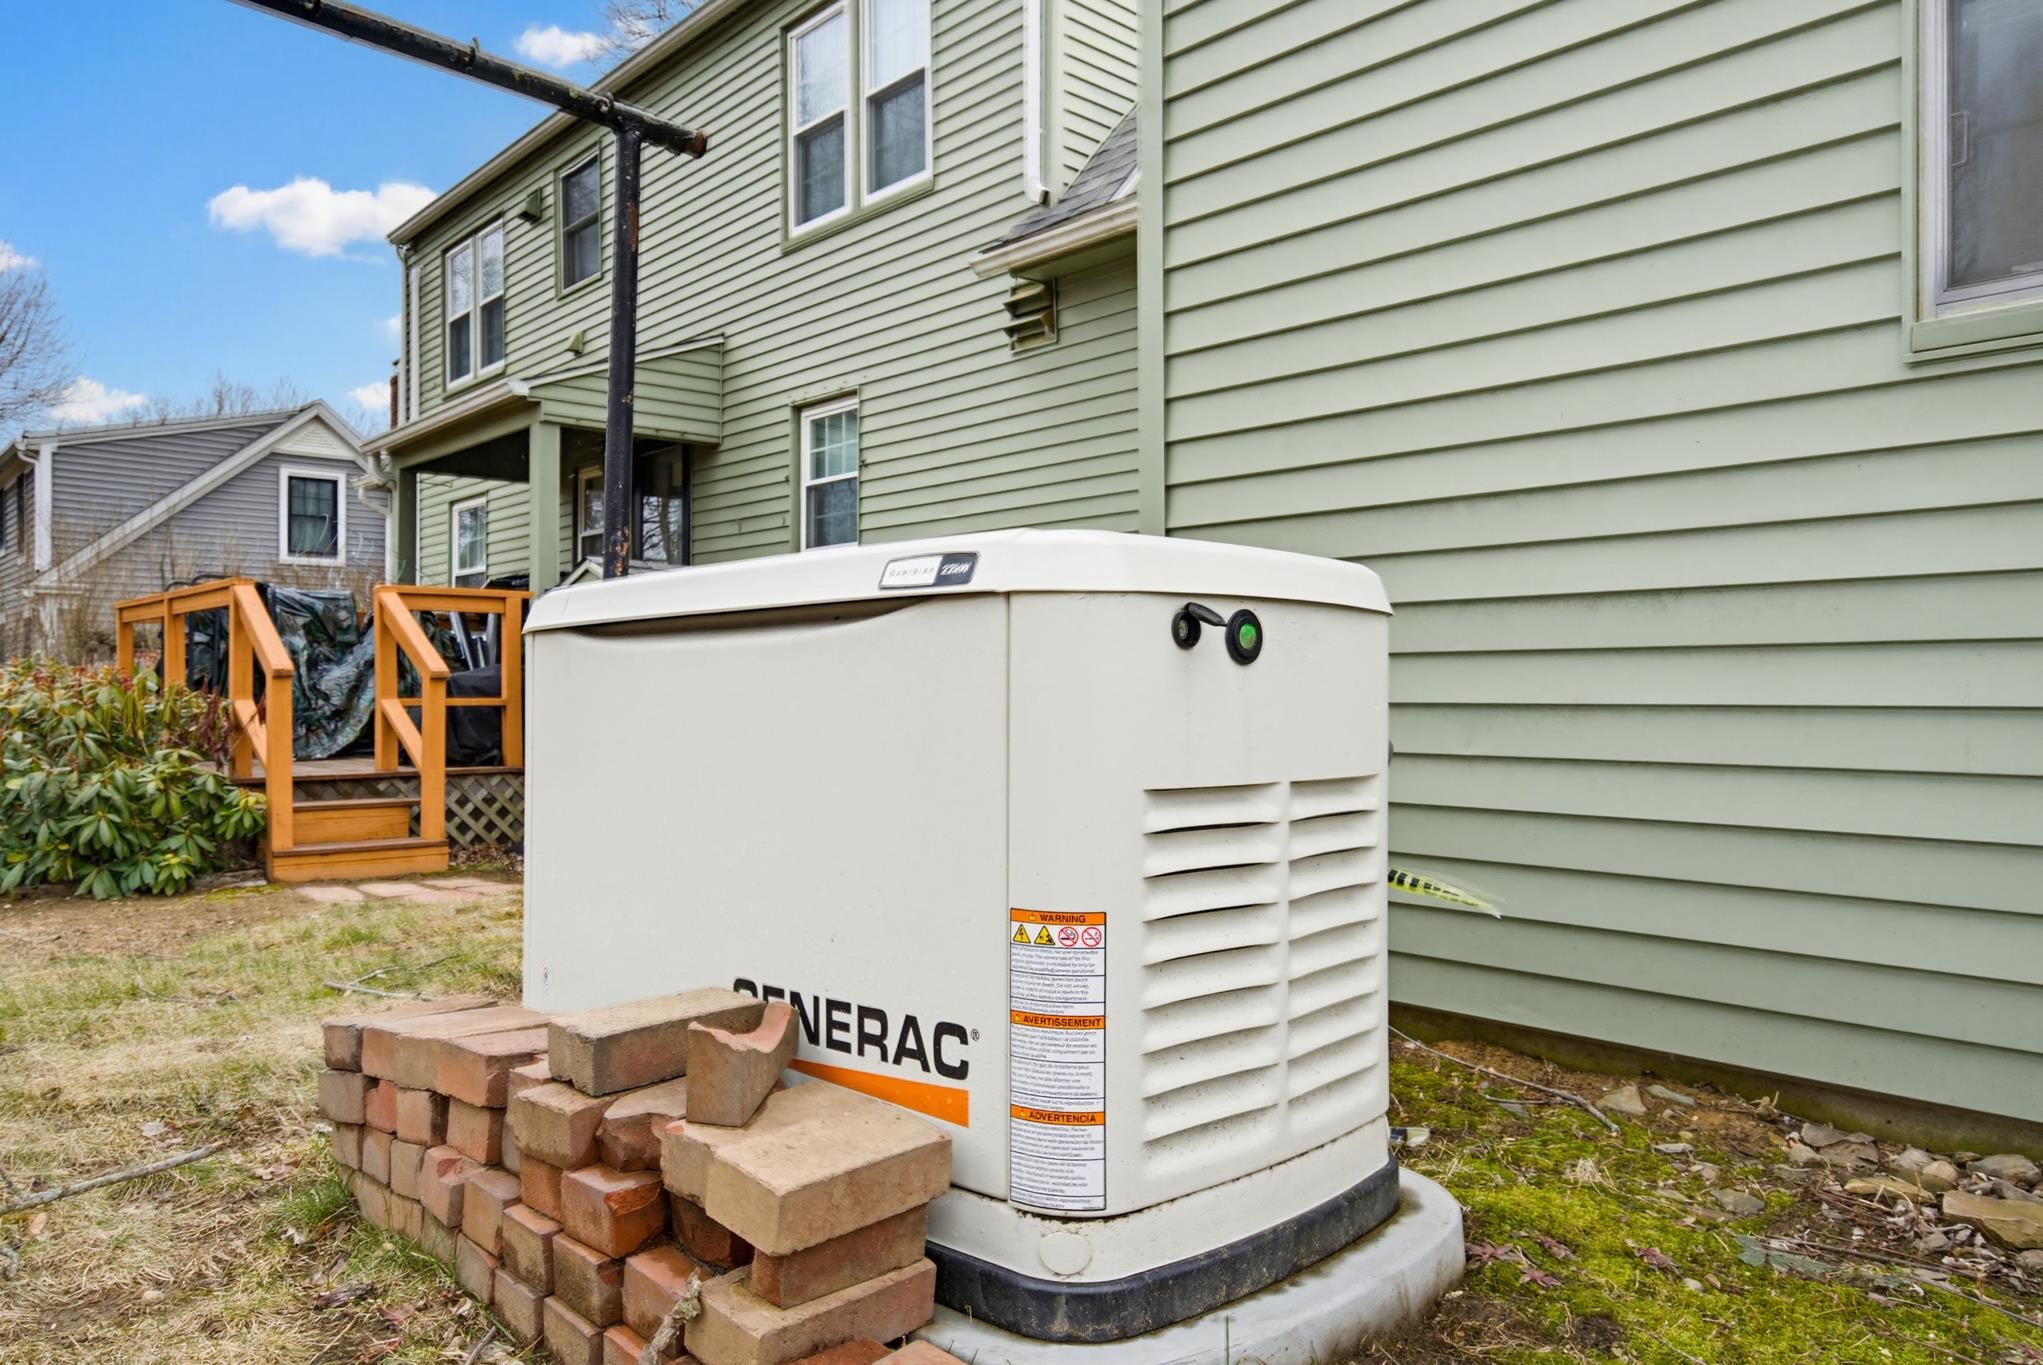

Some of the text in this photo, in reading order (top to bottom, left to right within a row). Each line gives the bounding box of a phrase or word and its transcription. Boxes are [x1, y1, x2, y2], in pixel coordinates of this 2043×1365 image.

[1039, 913, 1086, 923] WARNING
[1023, 1015, 1101, 1027] AVERTISSEMENT
[1028, 1111, 1097, 1123] ADVERTENCIA
